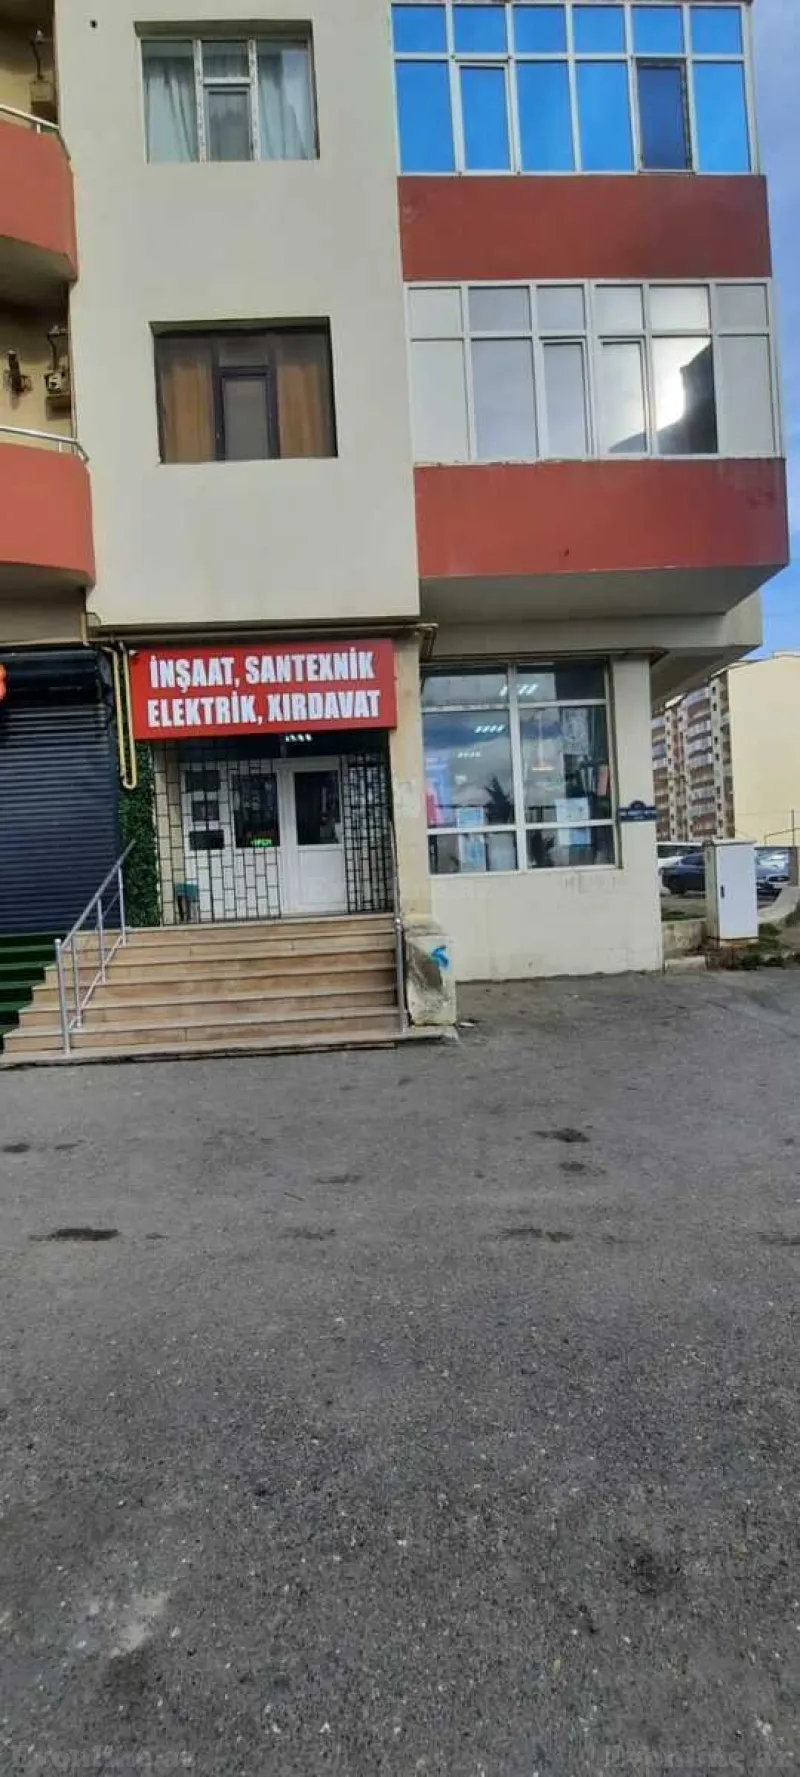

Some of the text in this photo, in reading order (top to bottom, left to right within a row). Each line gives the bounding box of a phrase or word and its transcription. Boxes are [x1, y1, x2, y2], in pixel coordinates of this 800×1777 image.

[150, 647, 375, 693] İNŞAAT, SANTEXNİK
[147, 690, 381, 727] ELEKTRİK, XIRDAVAT
